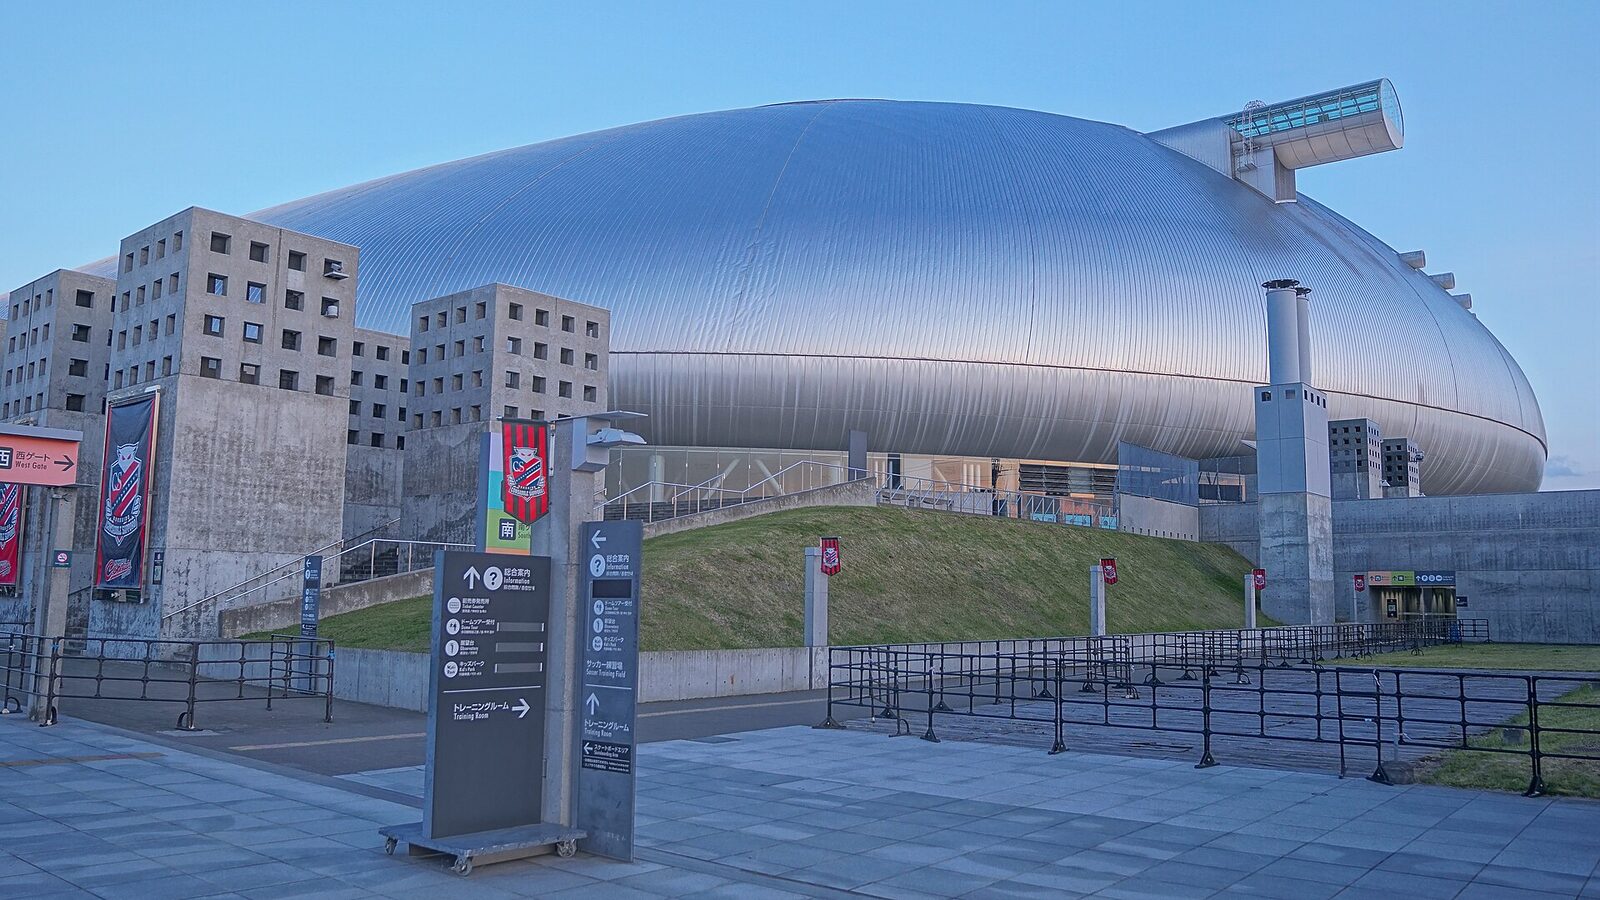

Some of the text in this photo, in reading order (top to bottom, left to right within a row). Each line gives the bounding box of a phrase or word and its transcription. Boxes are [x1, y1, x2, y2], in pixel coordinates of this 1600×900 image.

[16, 450, 51, 462] 西ゲート
[15, 460, 47, 470] West Gate
[501, 521, 514, 538] 南
[607, 554, 629, 562] 総合案内
[504, 568, 530, 577] 総合案内
[453, 701, 509, 713] トレーニングルーム
[453, 711, 489, 721] Training Room
[584, 719, 629, 731] トレーニングルーム
